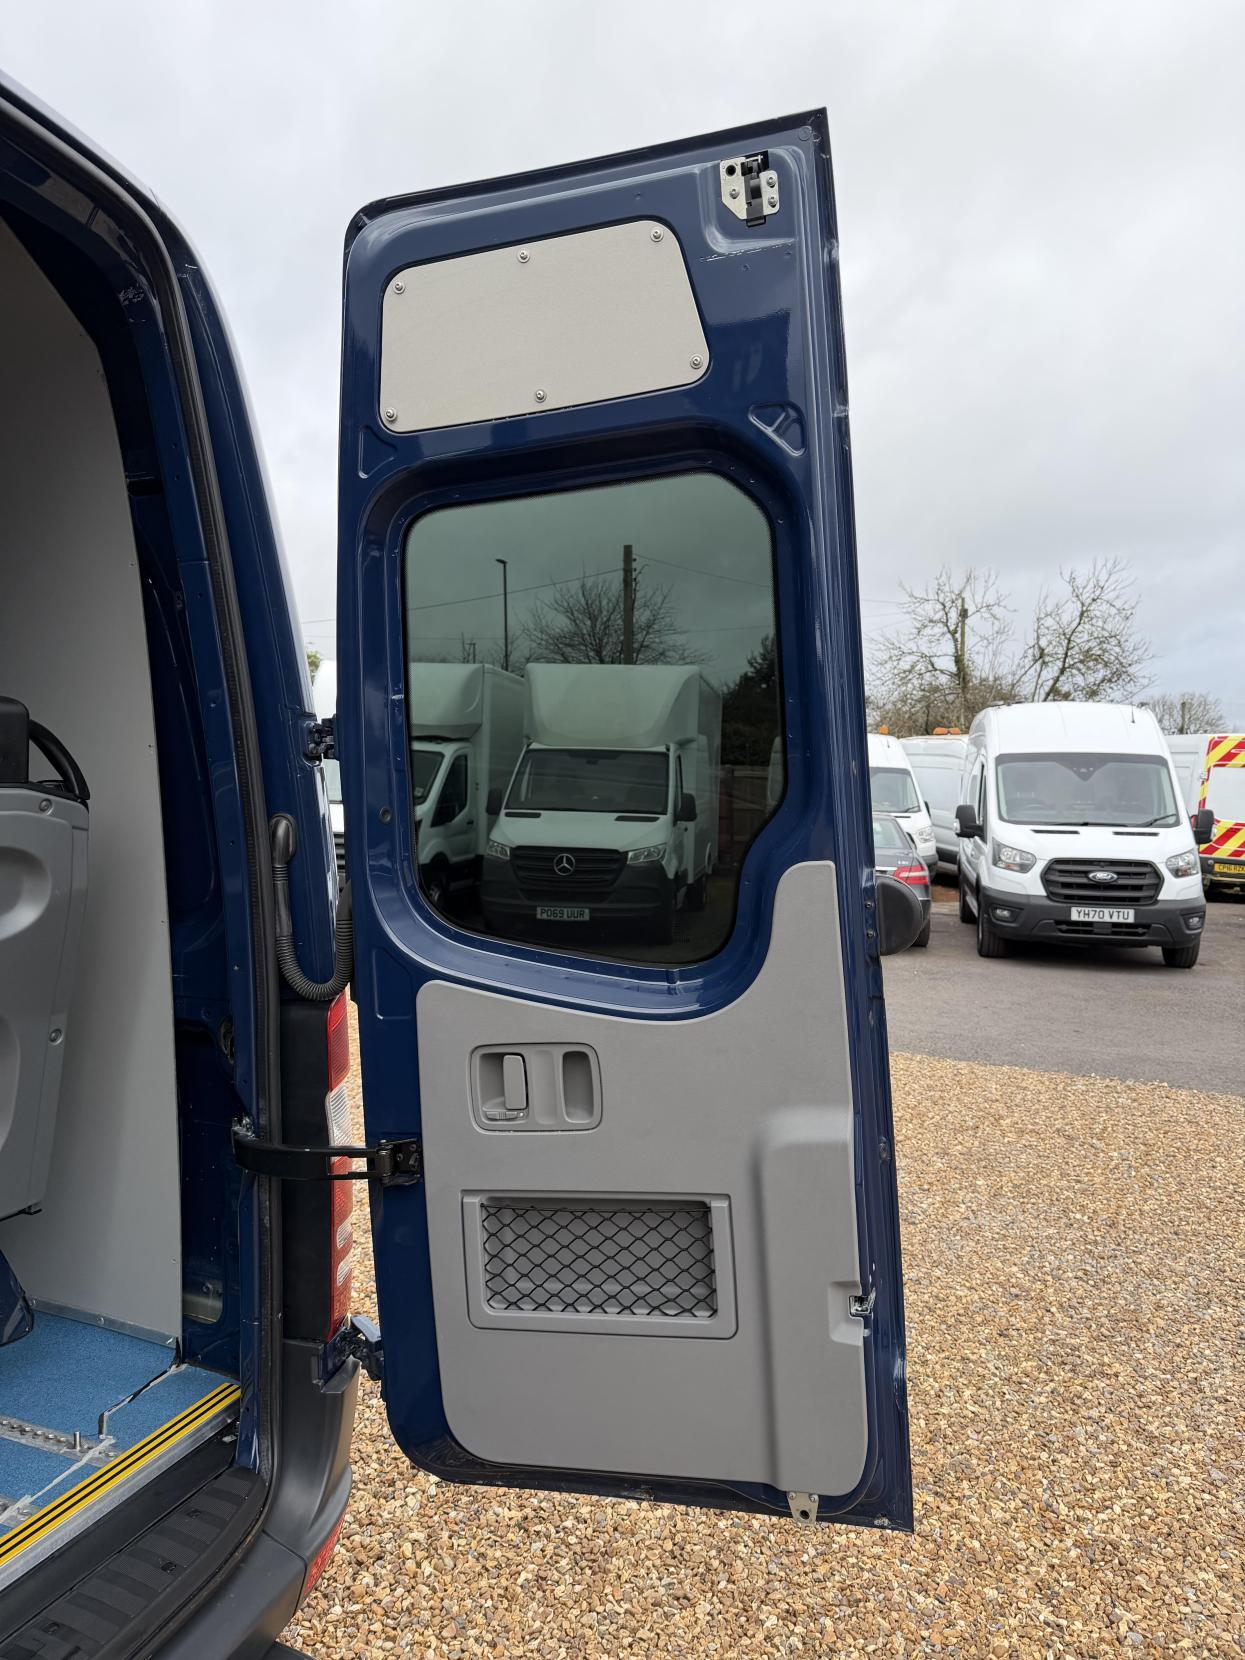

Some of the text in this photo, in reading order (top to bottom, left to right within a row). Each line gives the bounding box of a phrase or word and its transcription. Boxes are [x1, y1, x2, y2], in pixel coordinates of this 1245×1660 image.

[540, 908, 585, 919] PO69 UUR
[1076, 909, 1130, 921] YH70 VTU
